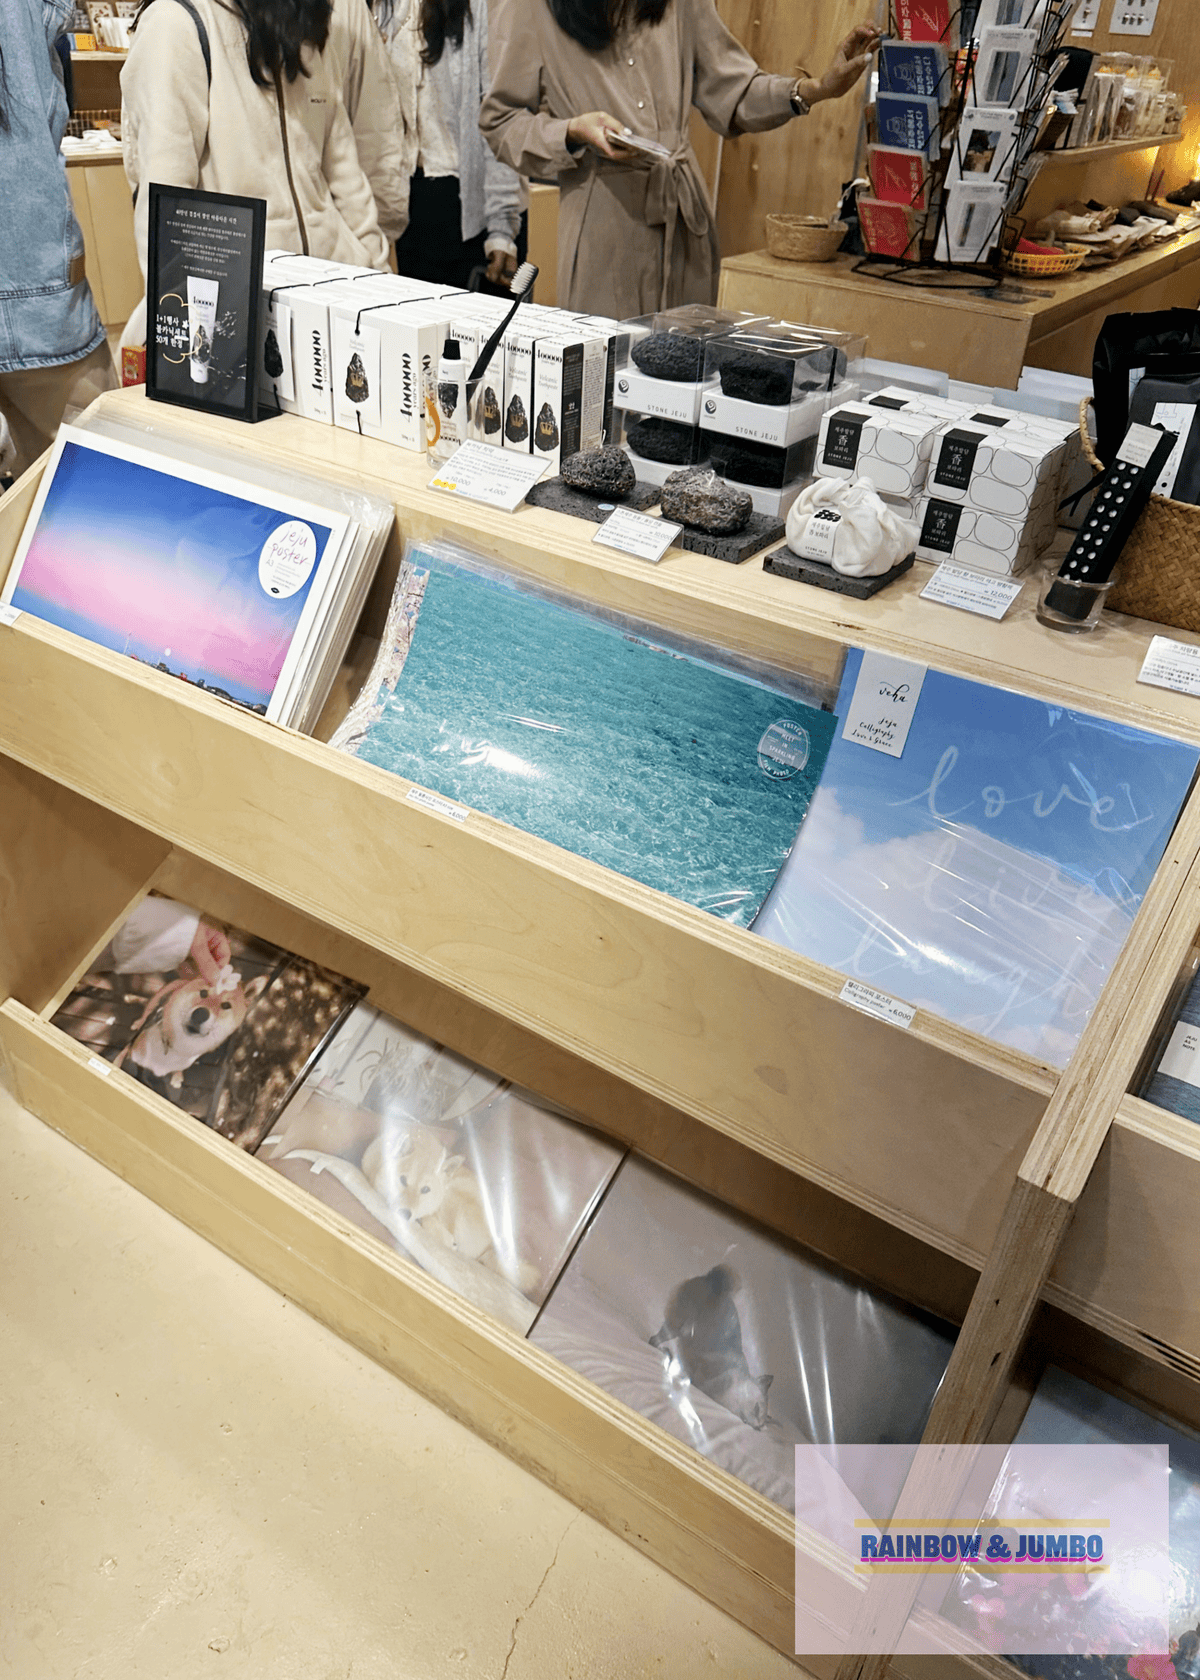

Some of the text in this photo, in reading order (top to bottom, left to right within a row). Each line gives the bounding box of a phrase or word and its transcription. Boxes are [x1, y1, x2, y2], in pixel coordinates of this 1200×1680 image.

[156, 314, 180, 327] 1+1행사
[155, 335, 169, 346] 50개
[647, 404, 688, 419] STONE JEJU
[735, 426, 779, 442] STONE JEJU
[450, 475, 471, 486] 10,000
[488, 487, 507, 496] 4,000
[280, 524, 308, 547] jeju
[270, 543, 308, 565] poster
[265, 559, 274, 567] A3
[990, 589, 1013, 600] 12,000
[783, 723, 803, 736] POSTER
[859, 722, 895, 740] Calligraphy
[781, 733, 795, 742] MEET
[851, 729, 867, 739] Love
[874, 737, 893, 747] Grace
[769, 745, 796, 760] SPARKLING
[888, 745, 1153, 833] love
[844, 987, 885, 1009] Calligraphy poster
[848, 981, 892, 1005] 캘리그라피 포스터
[1182, 1043, 1195, 1051] NOTE
